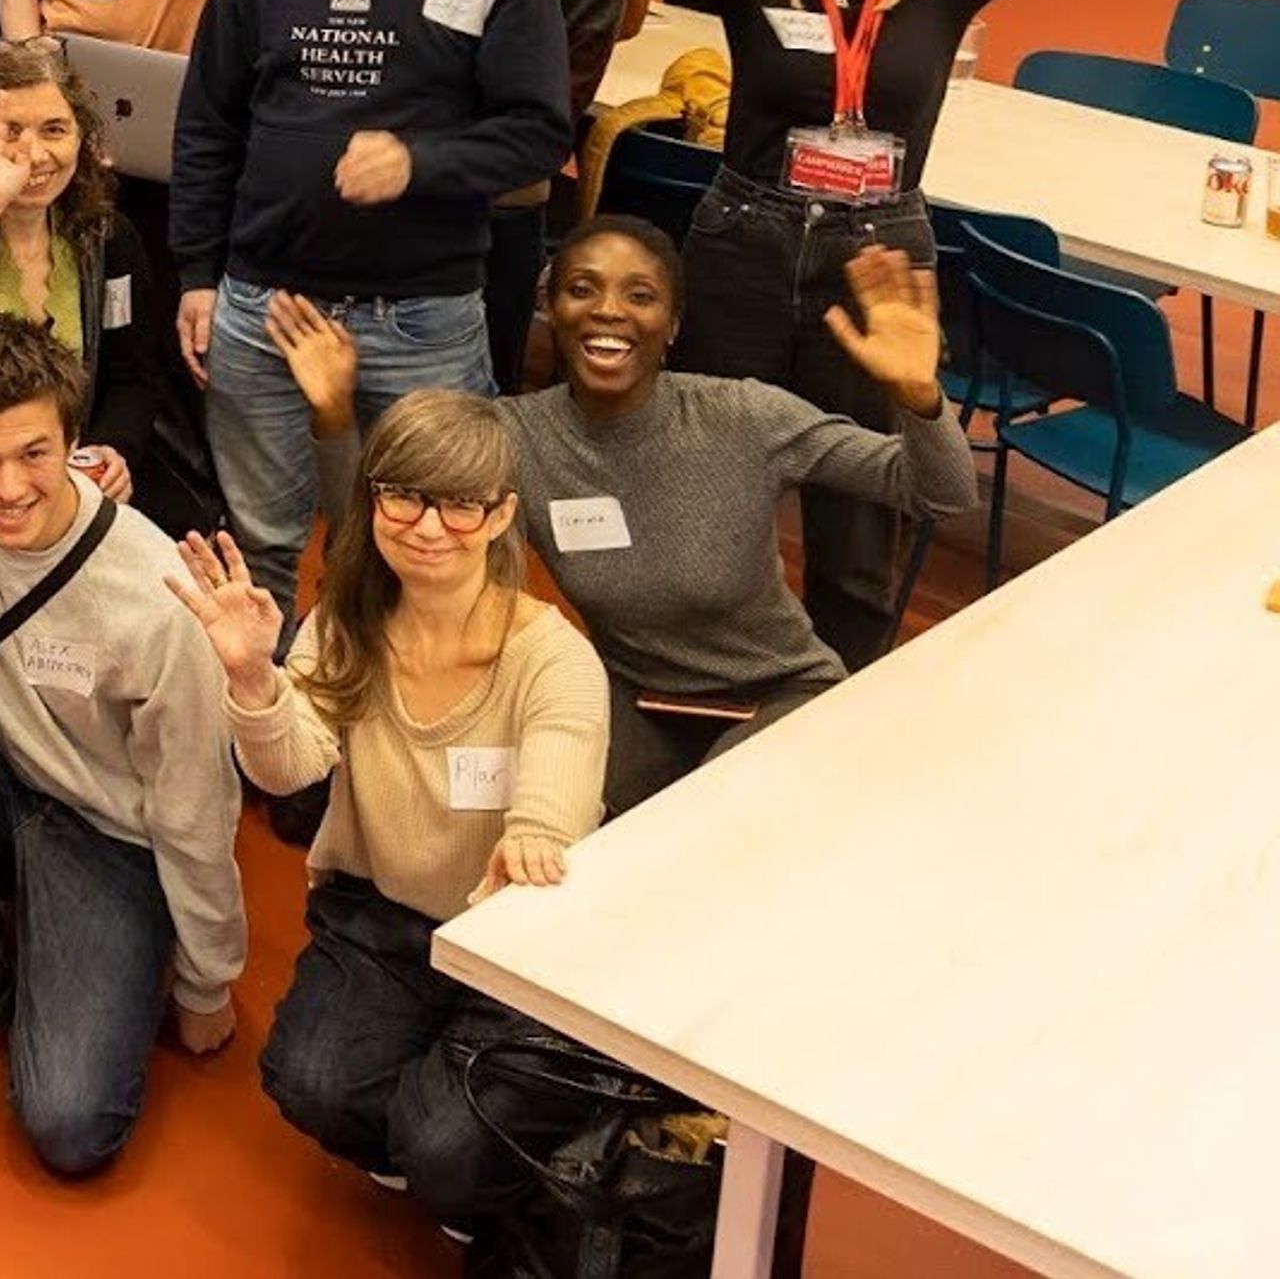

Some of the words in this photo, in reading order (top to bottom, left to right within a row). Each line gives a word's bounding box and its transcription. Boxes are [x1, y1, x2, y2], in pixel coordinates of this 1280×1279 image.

[290, 26, 400, 46] NATIONAL
[301, 47, 384, 64] HEALTH
[300, 67, 382, 85] SERVICE
